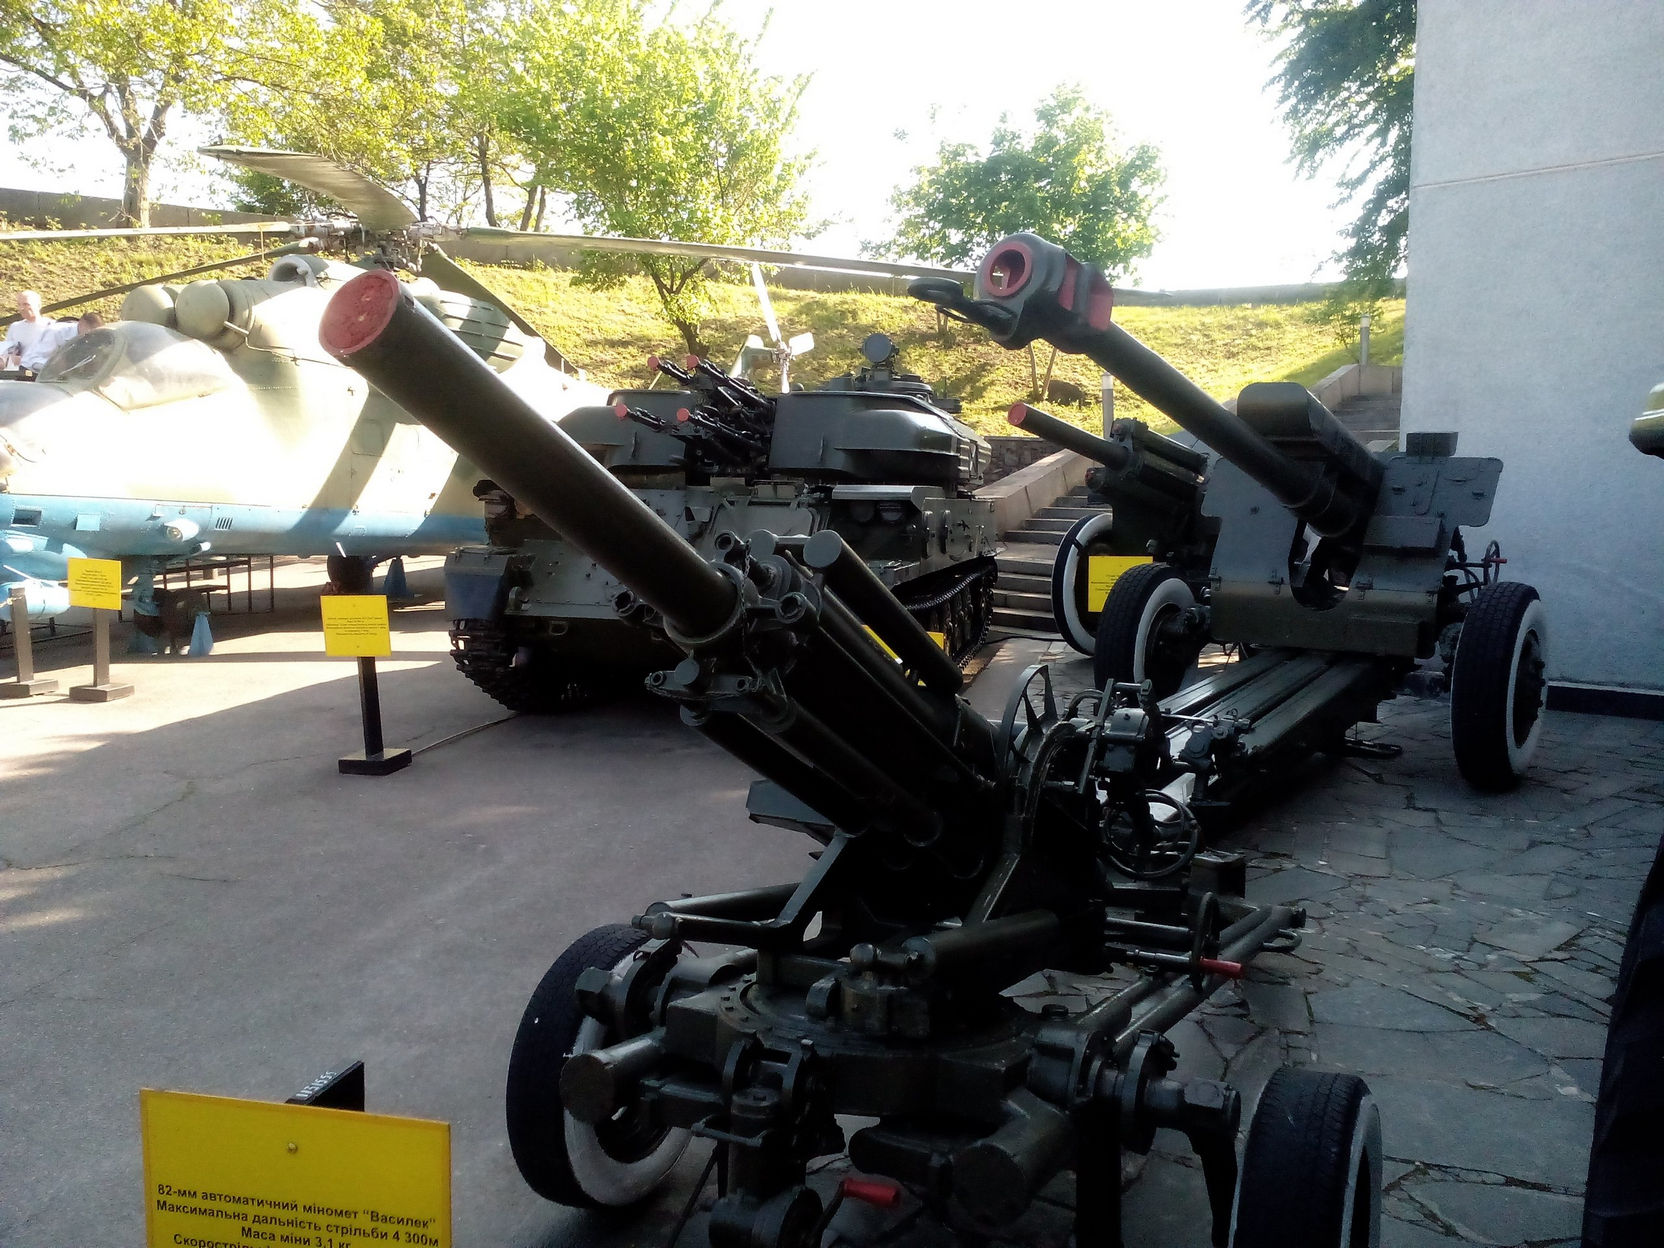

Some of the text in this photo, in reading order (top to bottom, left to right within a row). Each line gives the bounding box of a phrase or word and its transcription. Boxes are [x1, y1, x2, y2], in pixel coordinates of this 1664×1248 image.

[157, 1183, 197, 1199] 82-мм
[201, 1190, 298, 1212] автоматичний
[302, 1203, 359, 1220] міномет
[156, 1199, 440, 1248] Максимальна дальність стрільби 4 300м
[241, 1226, 276, 1241] Маса
[280, 1233, 311, 1246] міни
